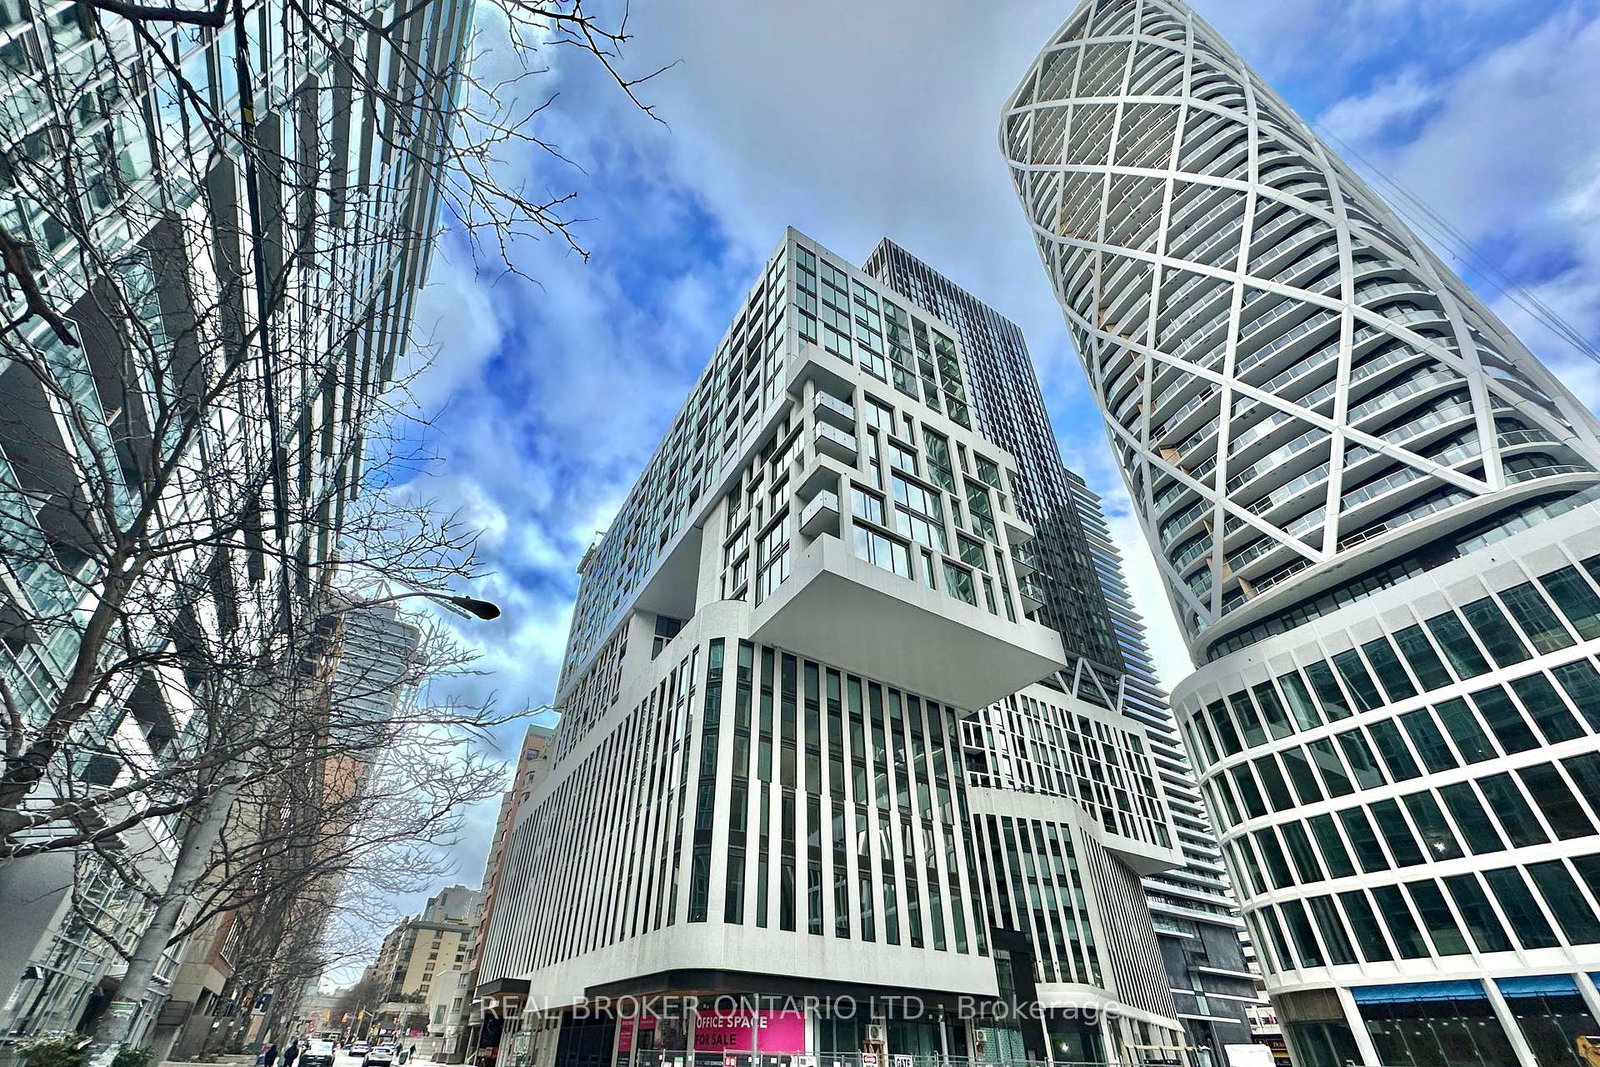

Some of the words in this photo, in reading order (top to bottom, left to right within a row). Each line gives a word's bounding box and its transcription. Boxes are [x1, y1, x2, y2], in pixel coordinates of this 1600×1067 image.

[696, 1018, 723, 1028] OFFICE
[727, 1016, 767, 1028] SPACE
[695, 1034, 710, 1045] FOR
[711, 1034, 736, 1046] SALE
